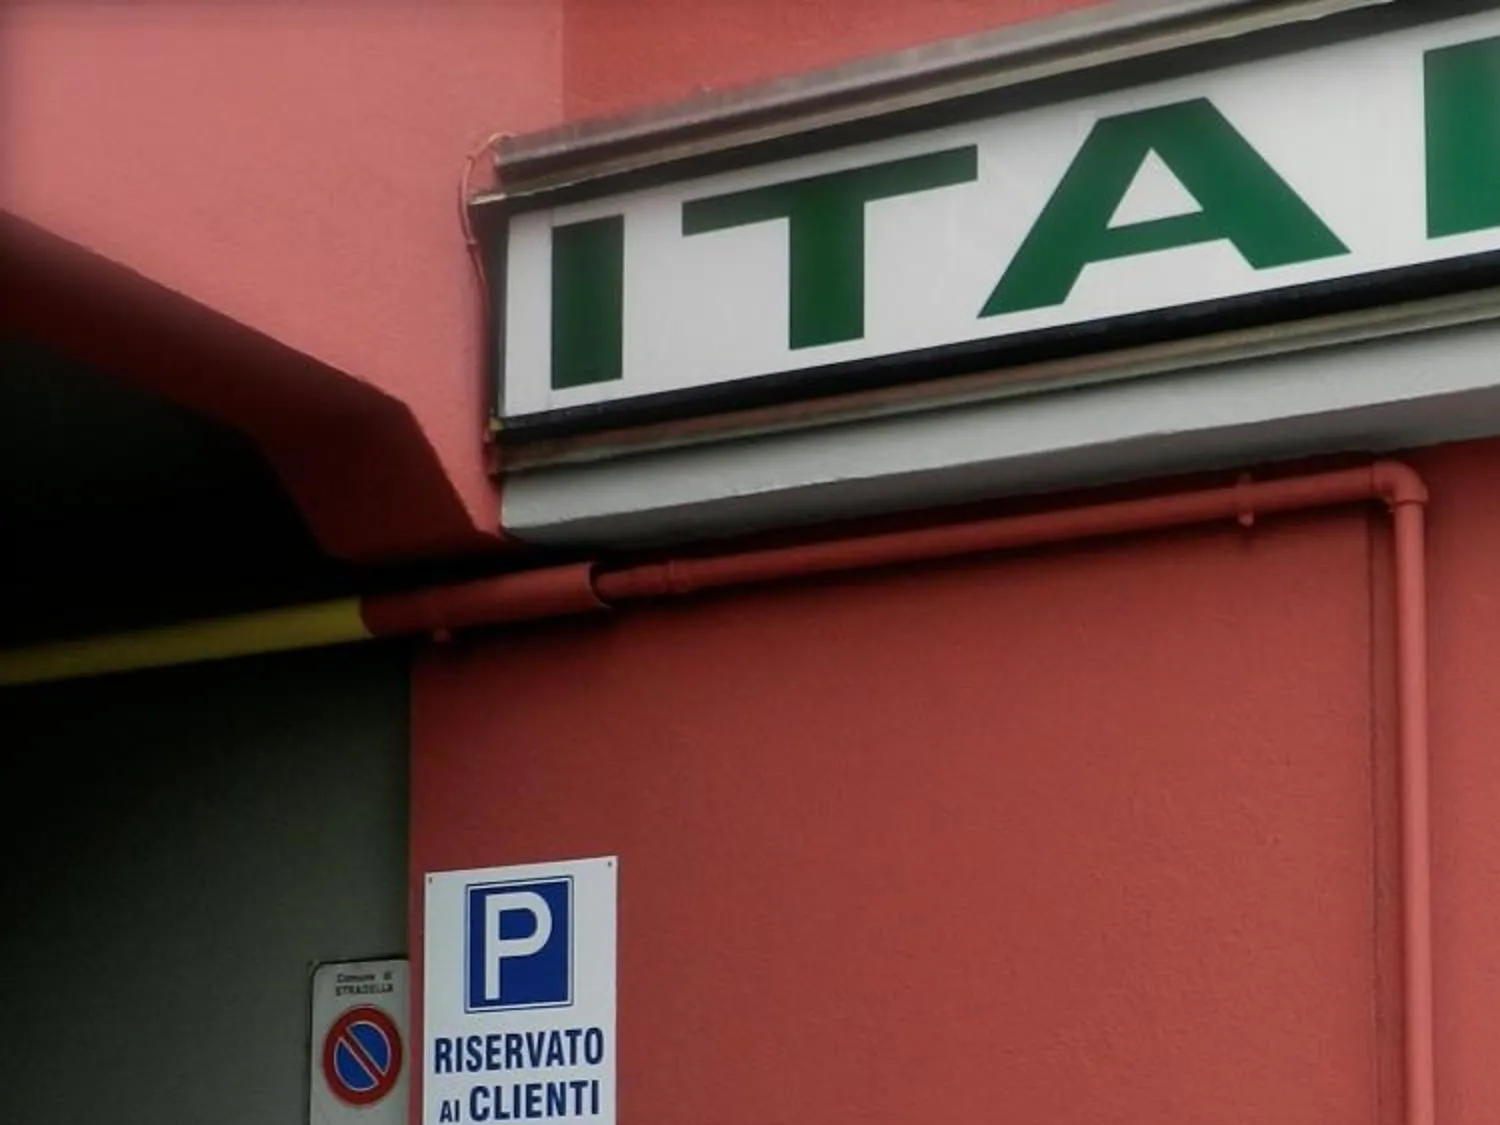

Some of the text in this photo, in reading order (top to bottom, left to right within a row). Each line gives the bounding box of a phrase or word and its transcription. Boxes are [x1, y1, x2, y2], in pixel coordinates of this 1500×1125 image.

[484, 891, 552, 1001] P
[434, 1027, 604, 1074] RISERVATO
[439, 1079, 599, 1123] AI CLIENTI
